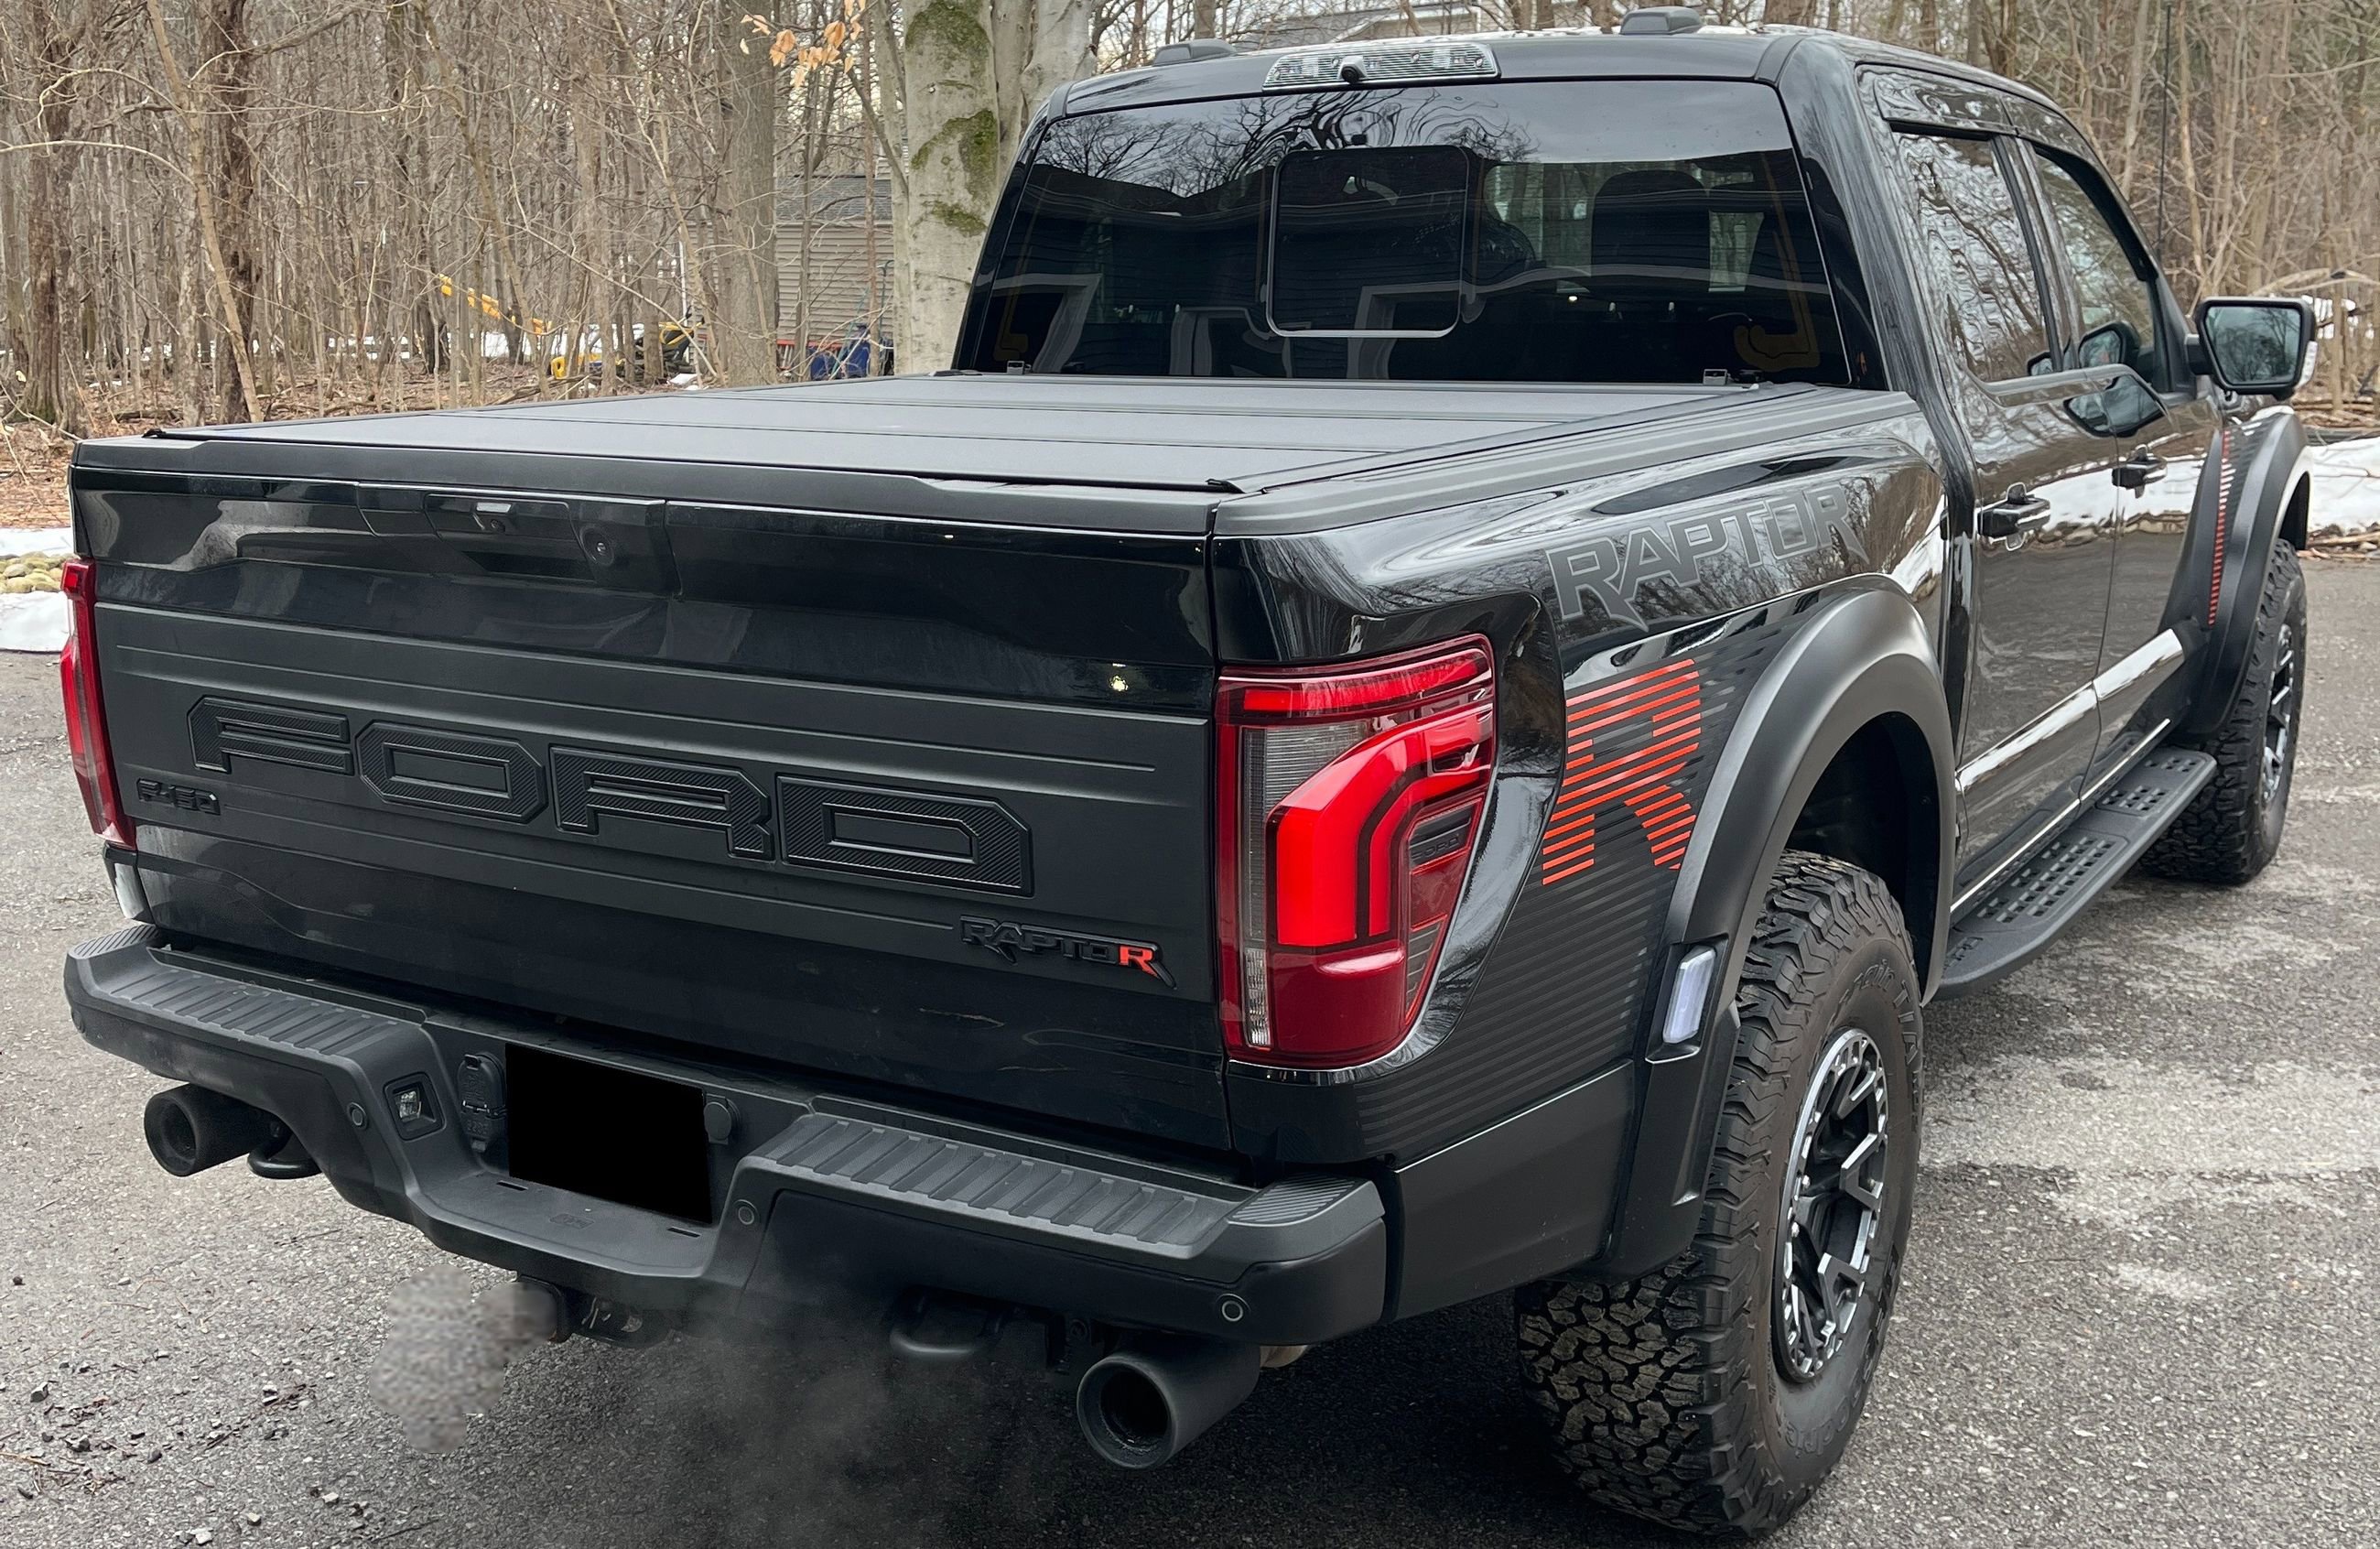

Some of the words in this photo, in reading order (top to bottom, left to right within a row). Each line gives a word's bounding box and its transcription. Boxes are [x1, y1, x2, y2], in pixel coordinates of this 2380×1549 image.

[1545, 486, 1870, 633] RAPTOR
[186, 695, 1035, 898] FORD
[959, 913, 1177, 991] RAPTOR
